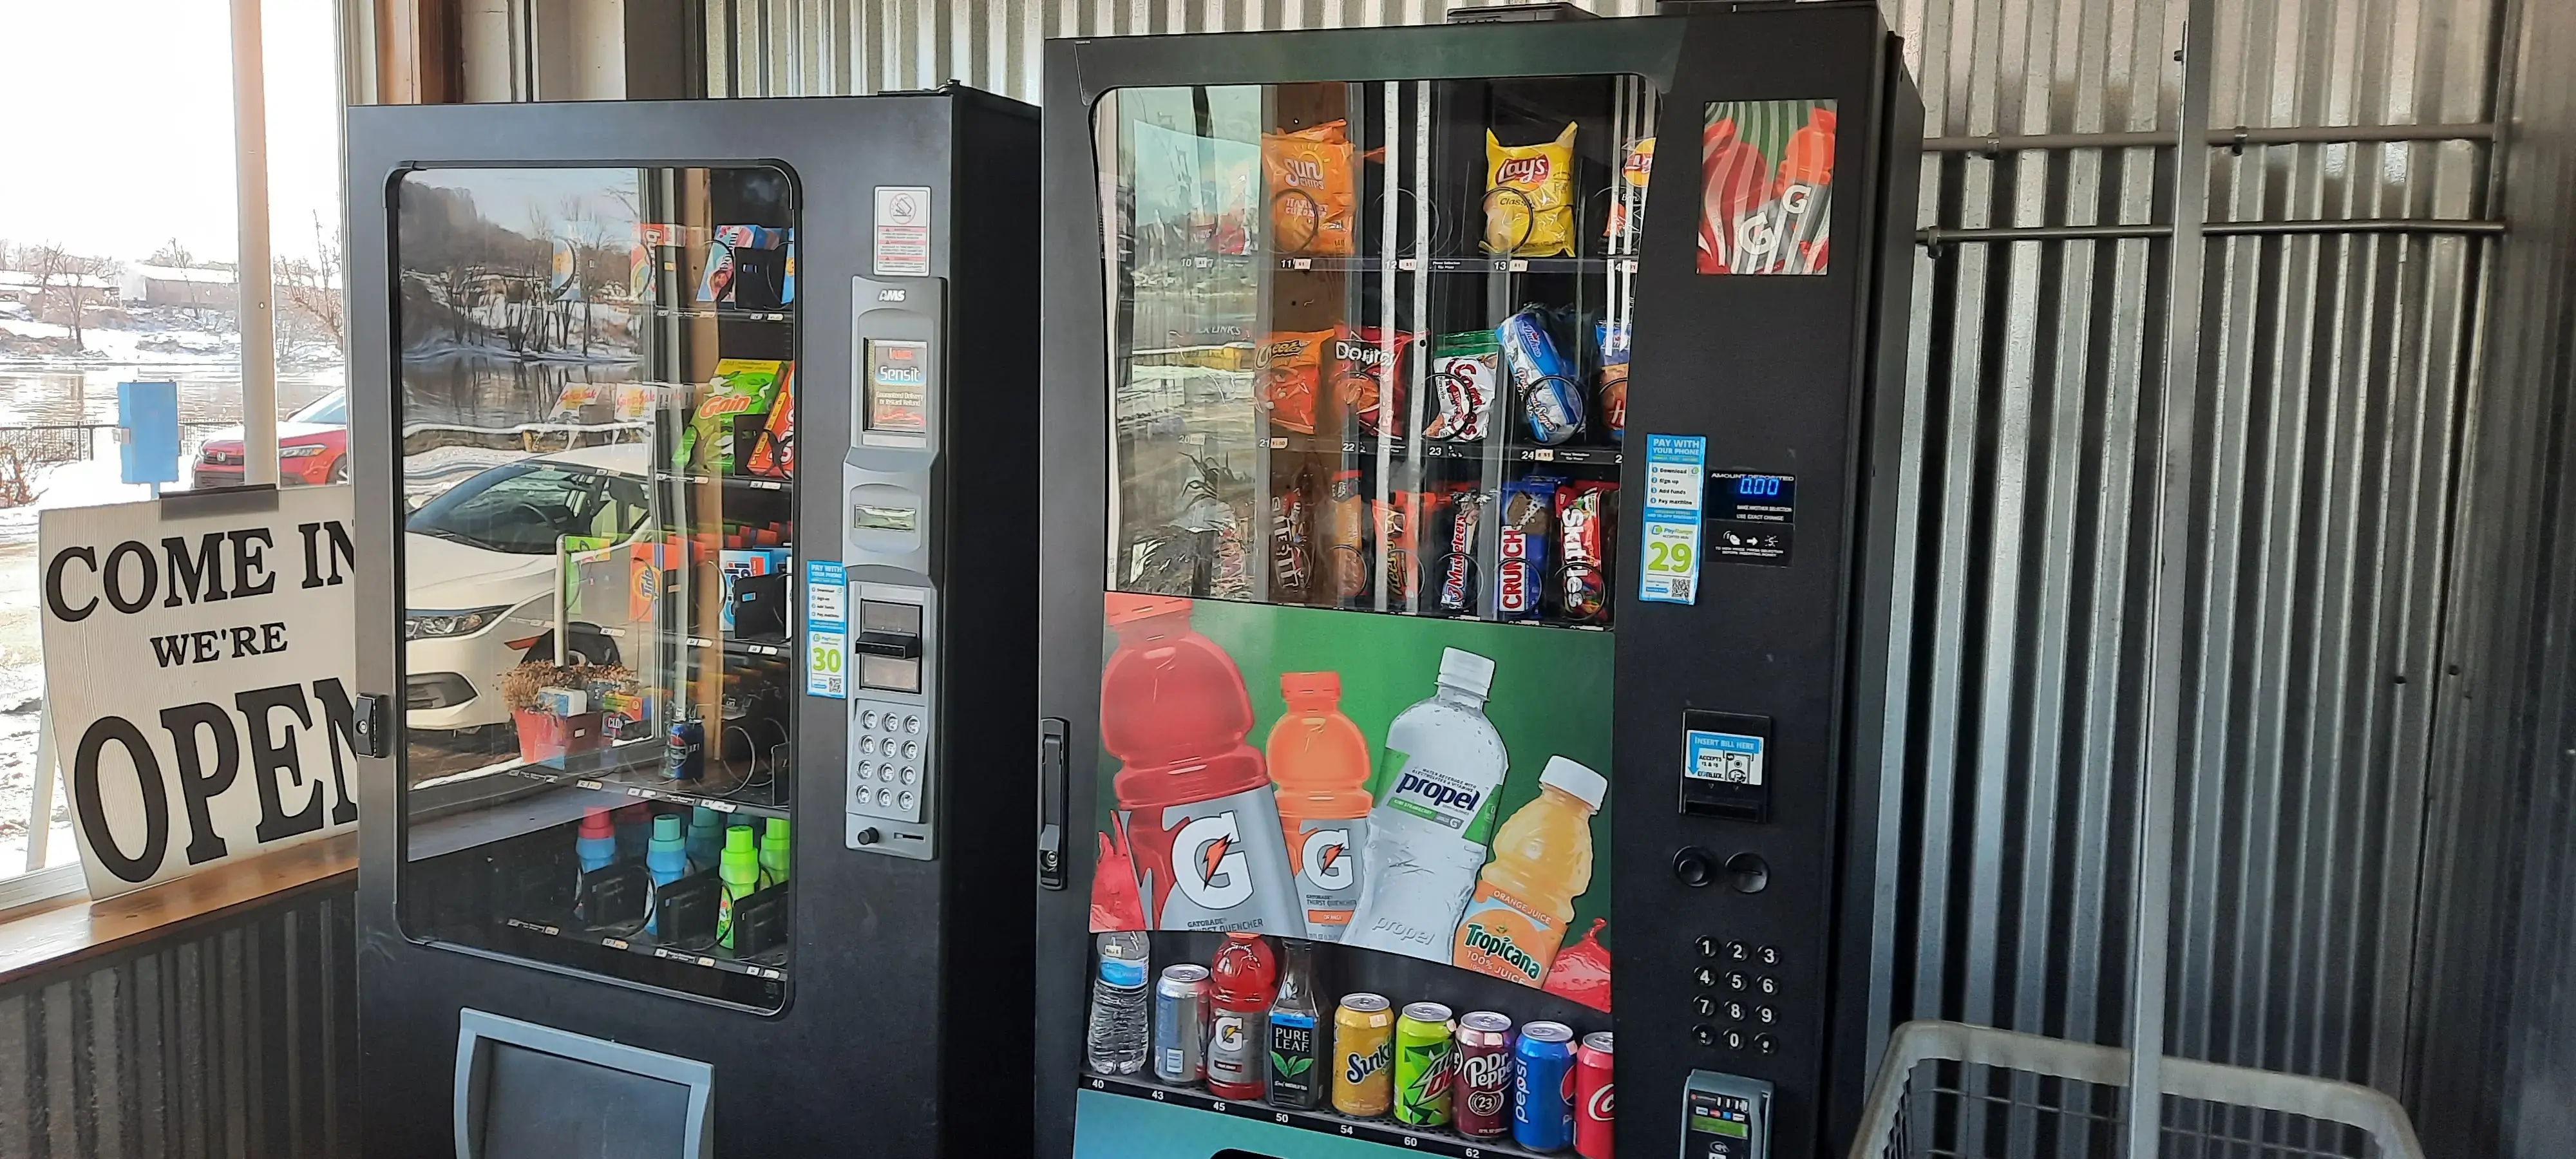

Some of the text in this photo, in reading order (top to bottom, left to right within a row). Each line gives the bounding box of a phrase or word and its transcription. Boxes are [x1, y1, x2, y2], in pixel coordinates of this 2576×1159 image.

[1285, 158, 1323, 186] Sun
[1498, 159, 1546, 183] Lay's
[1783, 185, 1812, 213] G
[1739, 212, 1777, 255] G
[1386, 261, 1397, 269] 12
[1495, 261, 1506, 270] 13
[878, 290, 906, 302] AMS
[880, 367, 919, 381] Sensit
[699, 395, 751, 419] Gain
[1343, 443, 1354, 451] 22
[1653, 438, 1700, 449] PAY WITH
[1522, 451, 1534, 460] 24
[1615, 455, 1622, 463] 2
[1740, 478, 1779, 495] 0.00
[1562, 508, 1588, 607] Skittles
[1648, 542, 1692, 573] 29
[1503, 525, 1522, 609] CRUNCH
[46, 528, 276, 622] COME
[150, 622, 288, 668] WE'RE
[813, 647, 841, 673] 30
[1694, 737, 1719, 746] INSERT
[74, 677, 358, 883] OPEN
[1396, 773, 1480, 811] propel
[1450, 818, 1461, 827] G
[1171, 811, 1255, 910] G
[1302, 829, 1354, 890] G
[1493, 890, 1552, 925] ORANGE JUICE
[1372, 915, 1435, 945] propel
[1465, 923, 1540, 979] Tropicana
[1702, 940, 1710, 954] 1
[1733, 945, 1743, 959] 2
[1467, 950, 1493, 970] 100%
[1764, 948, 1775, 963] 3
[1700, 970, 1710, 984] 4
[1731, 975, 1741, 989] 5
[1763, 979, 1774, 993] 6
[1700, 999, 1709, 1013] 7
[1730, 1004, 1741, 1018] 8
[1761, 1008, 1772, 1022] 9
[1215, 1017, 1244, 1051] G
[1276, 1028, 1309, 1042] PURE
[1730, 1033, 1739, 1048] 0
[1486, 1053, 1508, 1069] Dr
[1092, 1080, 1104, 1088] 40
[1515, 1057, 1530, 1124] pepsi
[1151, 1091, 1164, 1100] 43
[1213, 1102, 1225, 1111] 45
[1479, 1097, 1492, 1109] 23
[1276, 1114, 1288, 1122] 50
[1340, 1126, 1352, 1135] 54
[1404, 1137, 1417, 1146] 60
[1466, 1148, 1479, 1158] 62
